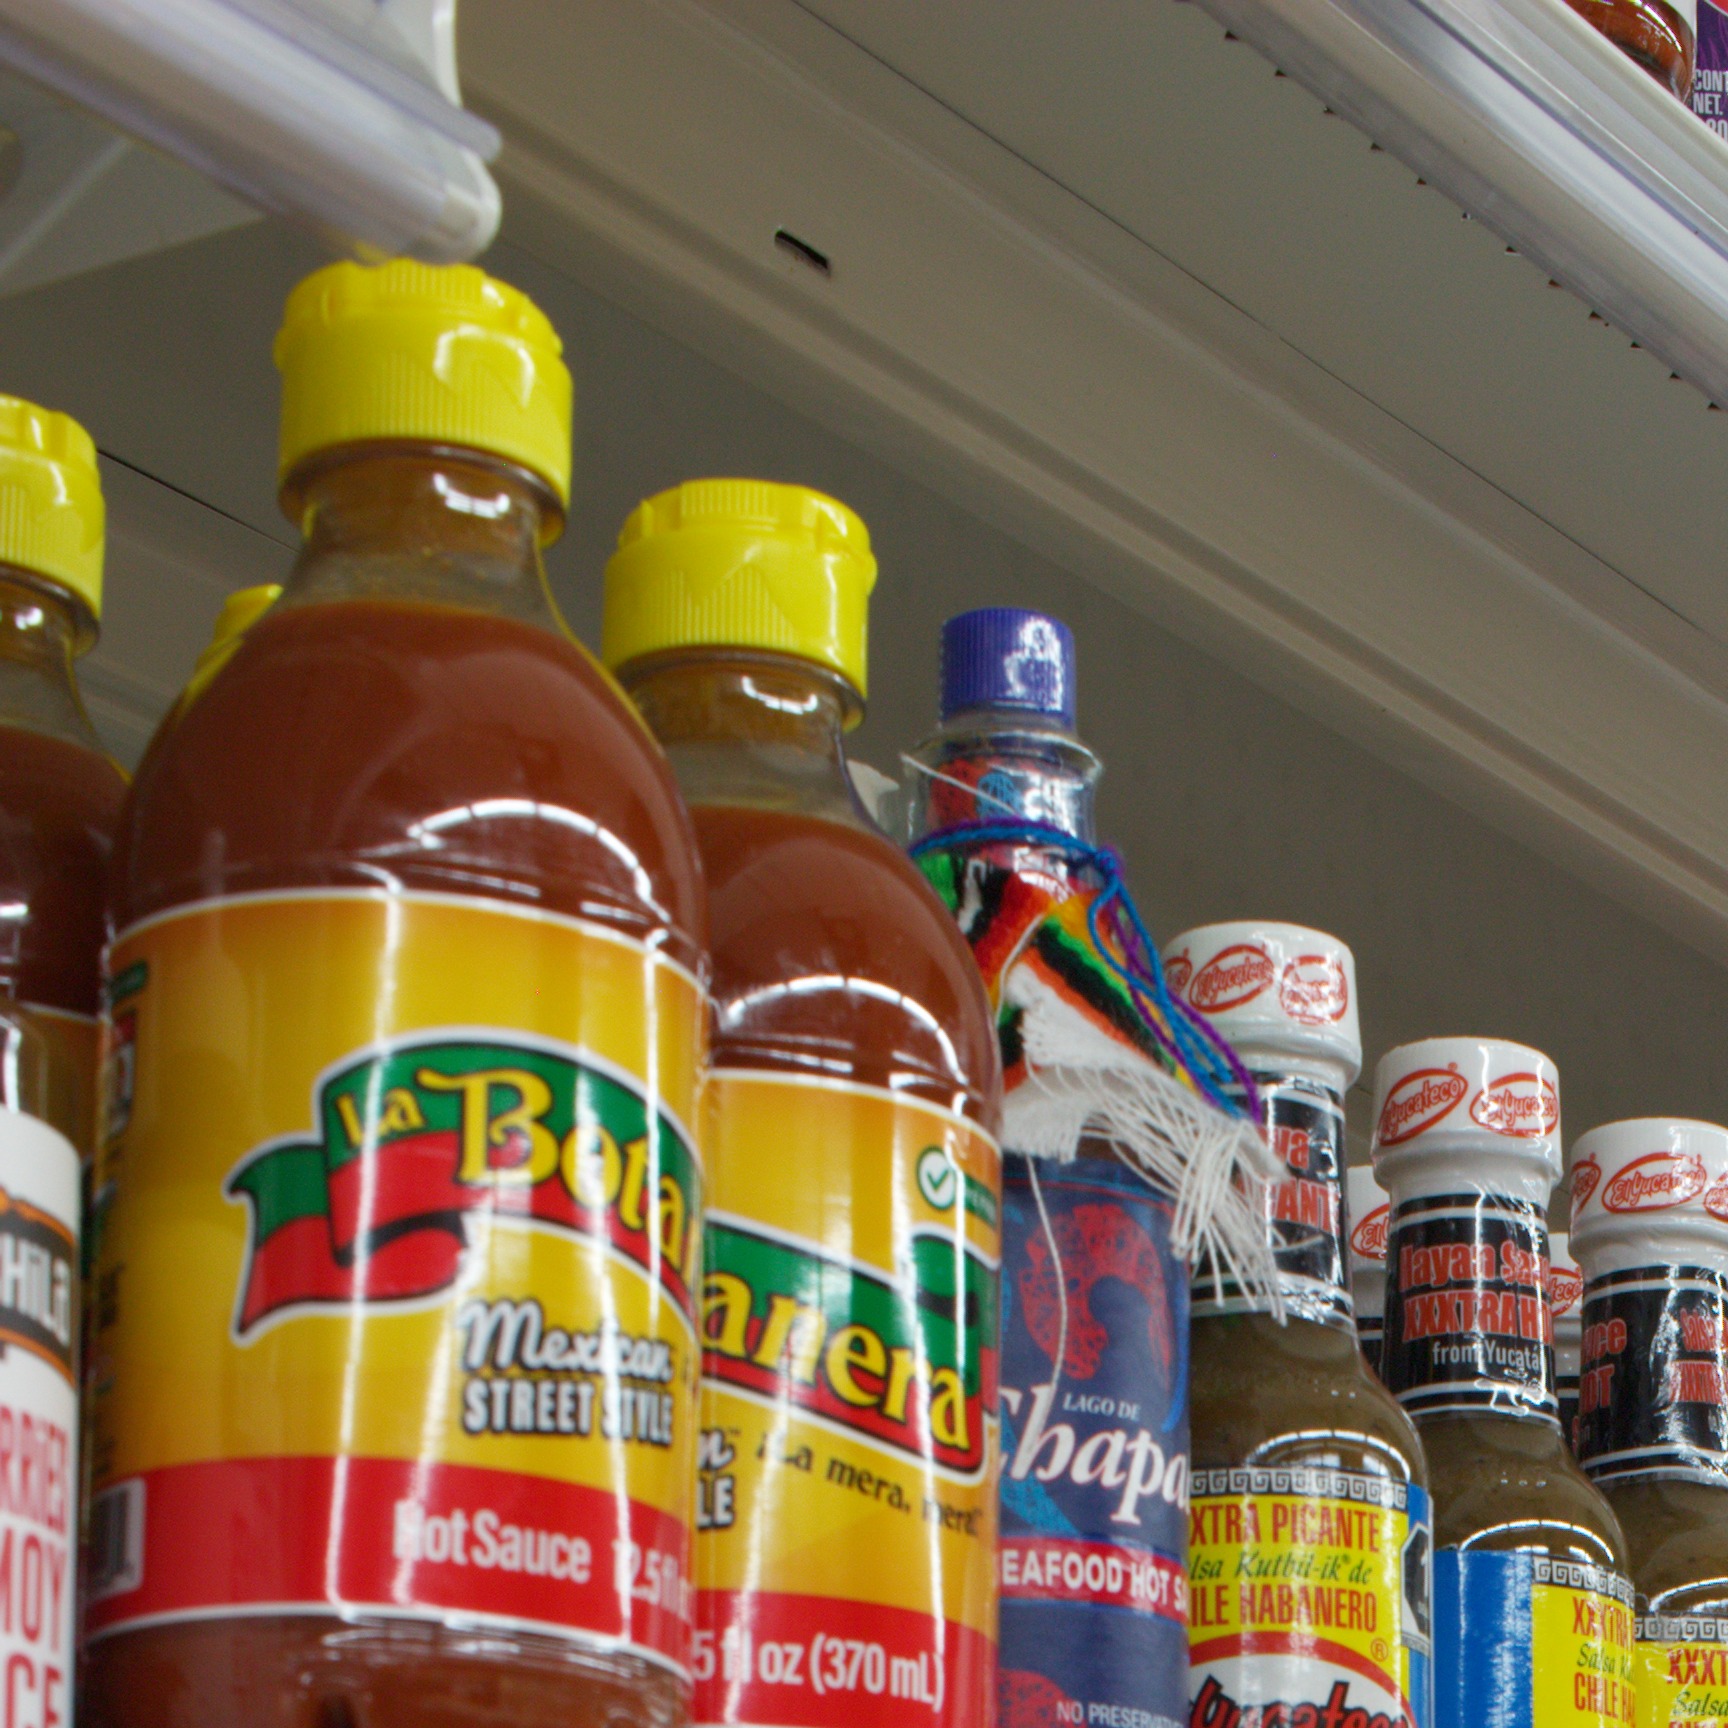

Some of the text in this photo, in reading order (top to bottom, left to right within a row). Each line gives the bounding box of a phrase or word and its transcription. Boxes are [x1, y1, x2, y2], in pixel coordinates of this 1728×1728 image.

[334, 1085, 423, 1152] La
[461, 1298, 674, 1382] Mexican
[1432, 1340, 1479, 1366] from
[463, 1384, 674, 1445] STREET STYLE
[1062, 1391, 1140, 1421] LAGO DE
[478, 1509, 591, 1584] Sauce
[1273, 1503, 1380, 1552] PICANTE
[1002, 1550, 1176, 1605] EAFOOD HOT
[1348, 1562, 1371, 1584] de
[1238, 1584, 1377, 1633] HABANERO
[760, 1648, 803, 1685] oz
[810, 1630, 886, 1696] (370
[1056, 1701, 1085, 1724] NO
